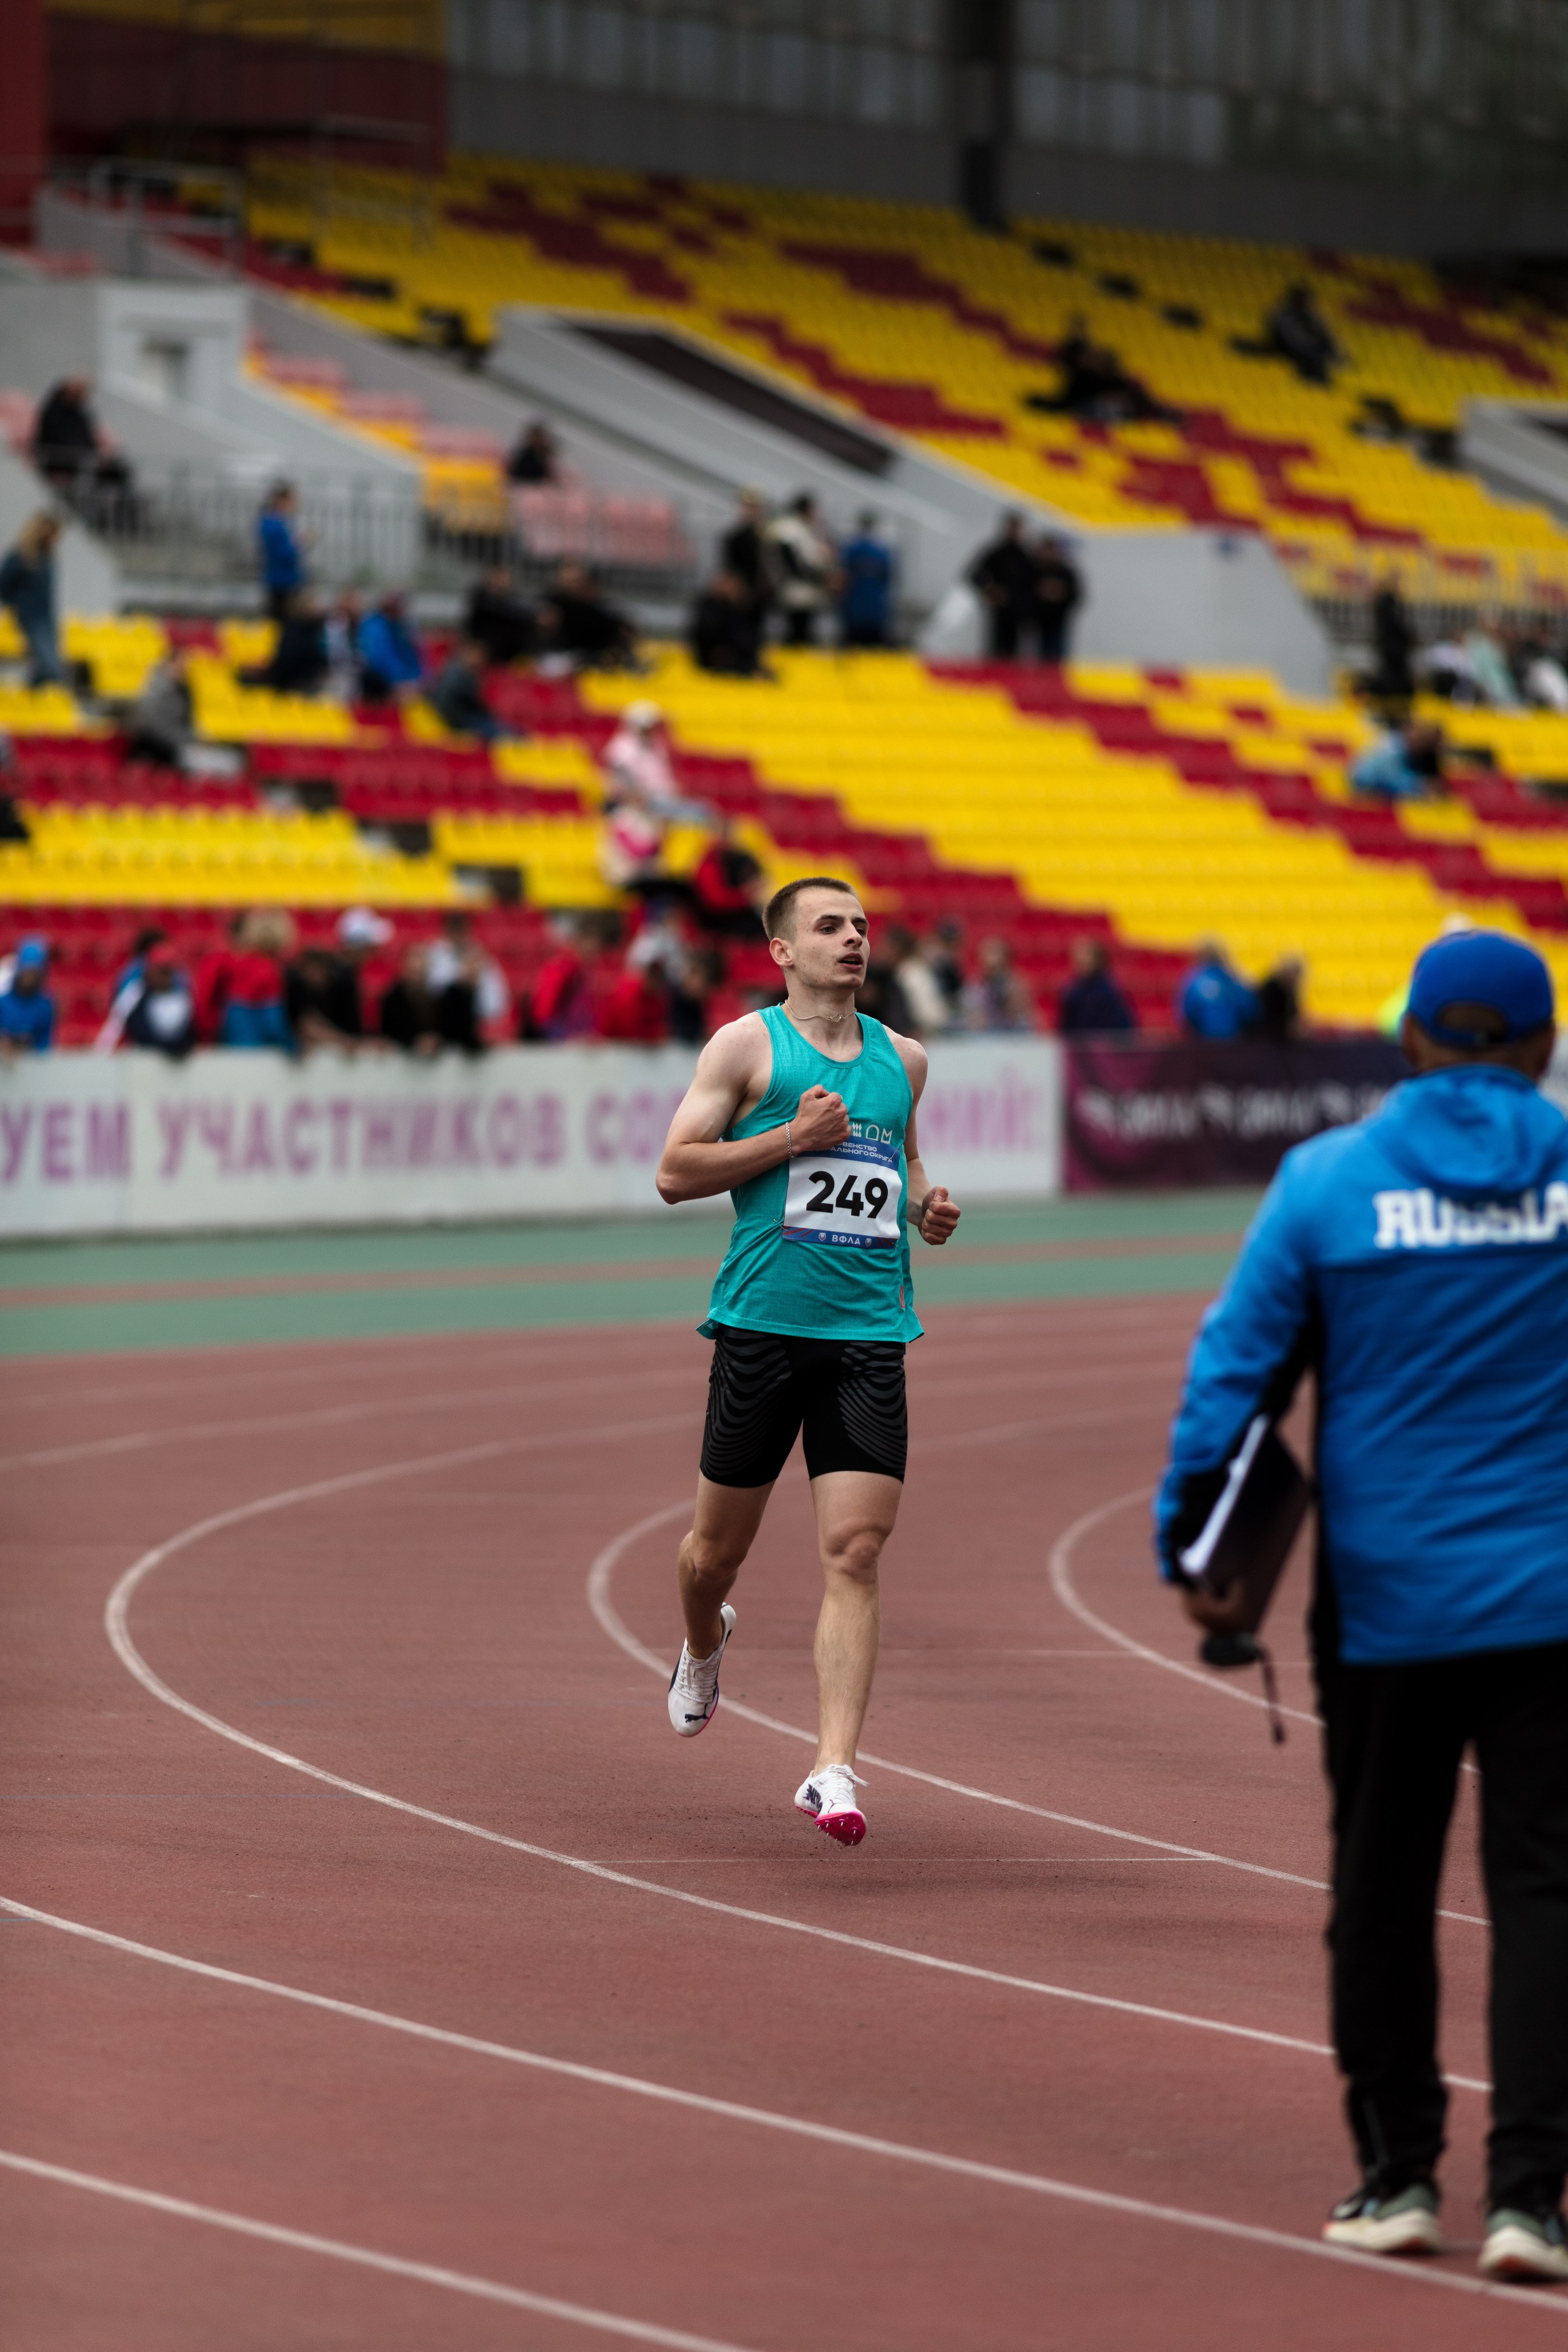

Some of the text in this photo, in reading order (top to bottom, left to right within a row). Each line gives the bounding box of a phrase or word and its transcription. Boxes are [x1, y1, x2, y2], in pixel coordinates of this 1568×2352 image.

[825, 1146, 892, 1163] АЛЬНОГО ОКРУГА
[806, 1170, 888, 1219] 249
[832, 1234, 861, 1245] ВФЛА
